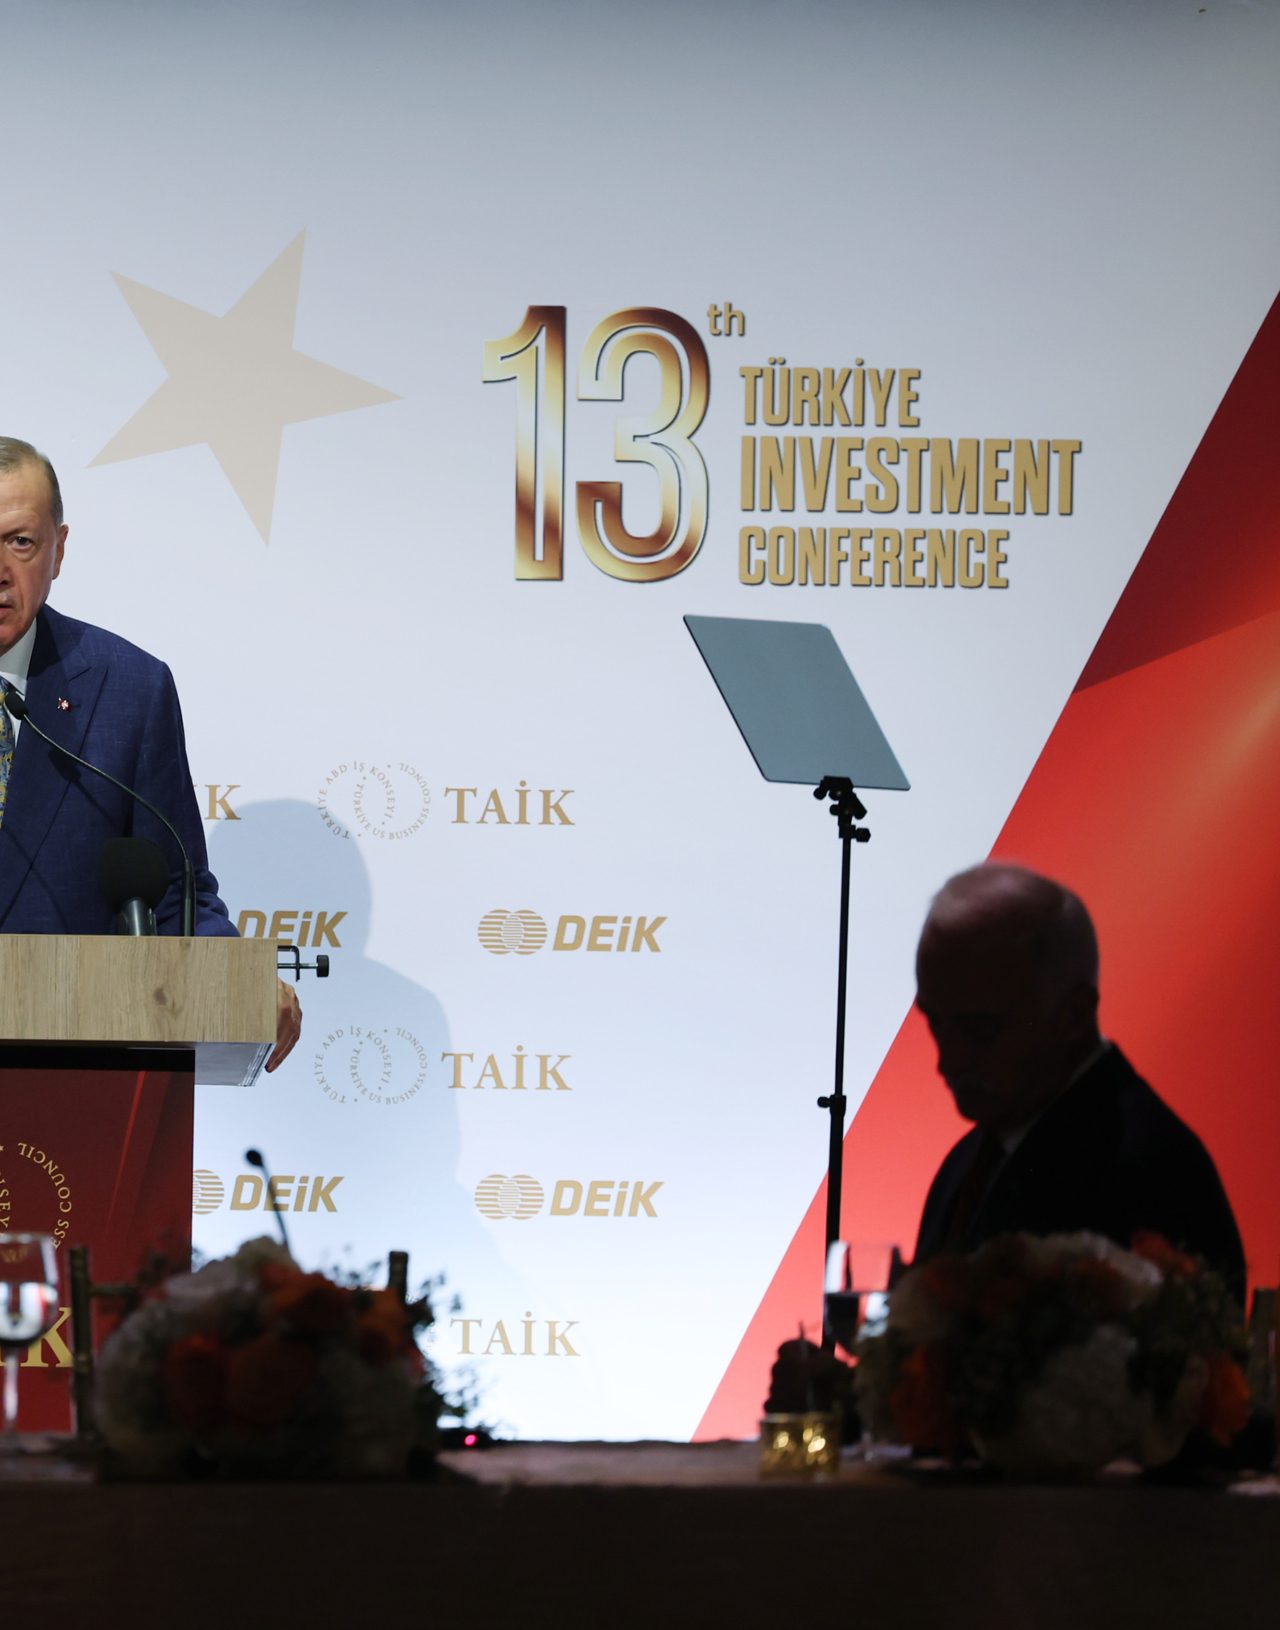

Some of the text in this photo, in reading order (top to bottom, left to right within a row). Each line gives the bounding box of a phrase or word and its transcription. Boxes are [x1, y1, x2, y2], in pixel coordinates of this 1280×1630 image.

[739, 357, 920, 427] TÜRKİYE
[740, 436, 1081, 516] INVESTMENT
[739, 526, 1009, 589] CONFERENCE
[445, 780, 576, 826] TAİK
[441, 1045, 572, 1091] TAİK
[18, 1142, 72, 1213] COUNCIL
[449, 1311, 581, 1357] TAİK
